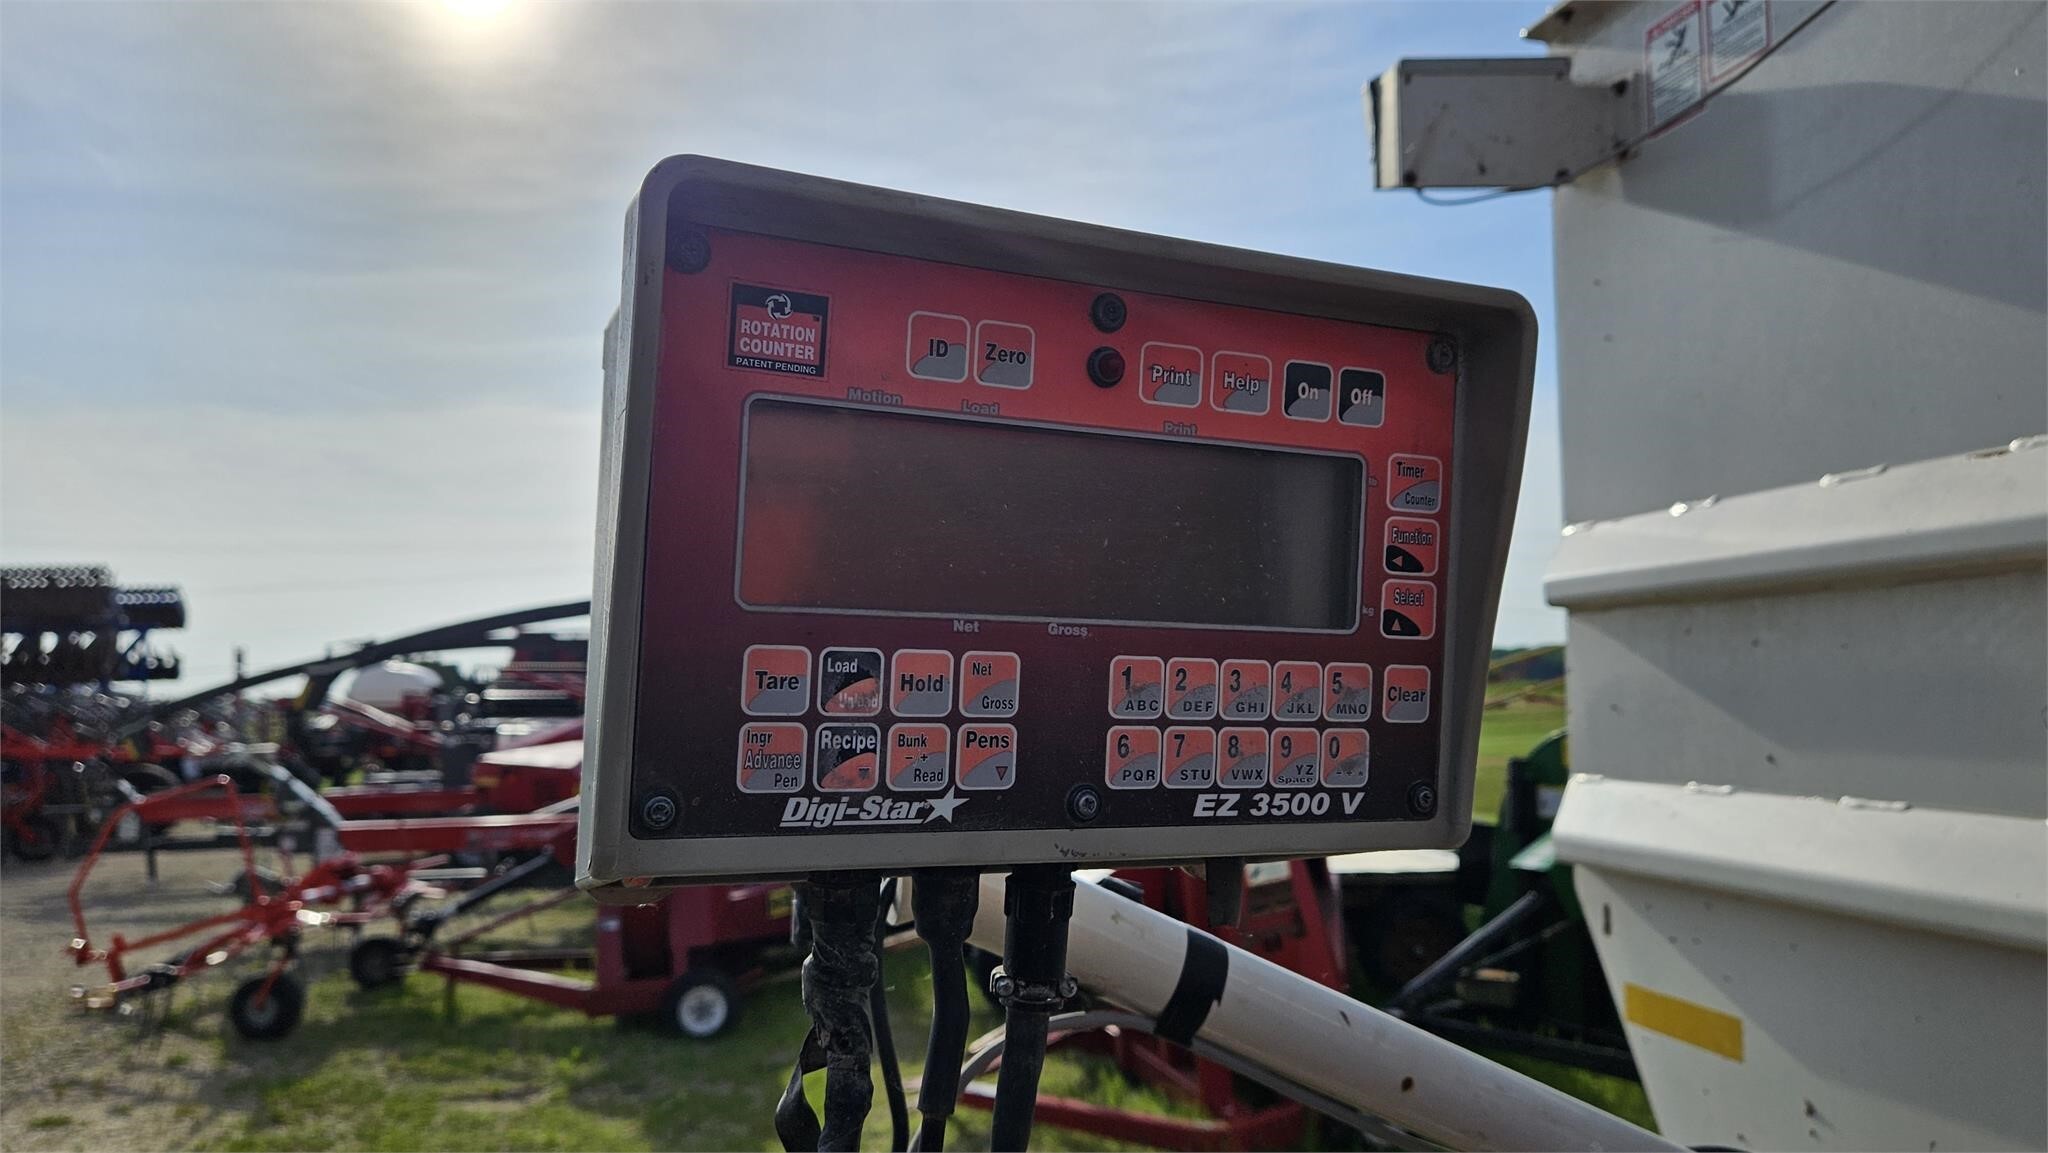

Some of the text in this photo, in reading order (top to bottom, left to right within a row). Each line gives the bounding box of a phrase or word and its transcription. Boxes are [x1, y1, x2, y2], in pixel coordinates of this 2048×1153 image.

[741, 318, 816, 342] ROTATION
[739, 336, 814, 361] COUNTER
[928, 338, 949, 358] ID
[985, 343, 1026, 365] Zero
[736, 356, 816, 376] PATENT PENDING
[1151, 366, 1192, 386] Print
[1223, 372, 1260, 394] Help
[848, 388, 902, 406] Motion
[1298, 382, 1318, 400] On
[1350, 388, 1373, 406] Off
[962, 400, 999, 416] Load
[1163, 421, 1197, 436] Print
[1396, 461, 1425, 479] Timer
[1405, 492, 1436, 507] Counter
[1392, 528, 1433, 546] Function
[1394, 588, 1424, 606] Select
[1362, 606, 1374, 618] kg
[954, 620, 980, 633] Net
[1048, 623, 1088, 637] Gross
[827, 658, 858, 673] Load
[972, 662, 992, 676] Net
[755, 670, 800, 691] Tare
[900, 674, 944, 693] Hold
[1121, 666, 1132, 690] 1
[1174, 668, 1188, 692] 2
[1230, 668, 1241, 693] 3
[1280, 671, 1292, 694] 4
[1332, 672, 1342, 694] 5
[1388, 686, 1426, 703] Clear
[982, 696, 1014, 712] Gross
[1124, 700, 1159, 712] ABC
[1183, 701, 1213, 712] DEF
[1236, 702, 1265, 713] GHI
[1286, 702, 1316, 714] JKL
[1336, 704, 1368, 714] MNO
[746, 730, 773, 748] Ingr
[820, 730, 876, 753] Recipe
[897, 733, 928, 748] Bunk
[965, 730, 1010, 749] Pens
[1117, 734, 1130, 758] 6
[1174, 734, 1186, 758] 7
[1228, 735, 1240, 758] 8
[1280, 736, 1292, 758] 9
[1329, 736, 1340, 759] 0
[744, 749, 801, 770] Advance
[914, 768, 944, 783] Read
[1122, 770, 1156, 782] PQR
[1180, 770, 1211, 781] STU
[1232, 769, 1264, 781] VWX
[1296, 764, 1314, 776] YZ
[774, 773, 798, 788] Pen
[1278, 776, 1313, 784] Space
[1193, 792, 1366, 817] EZ 3500 V
